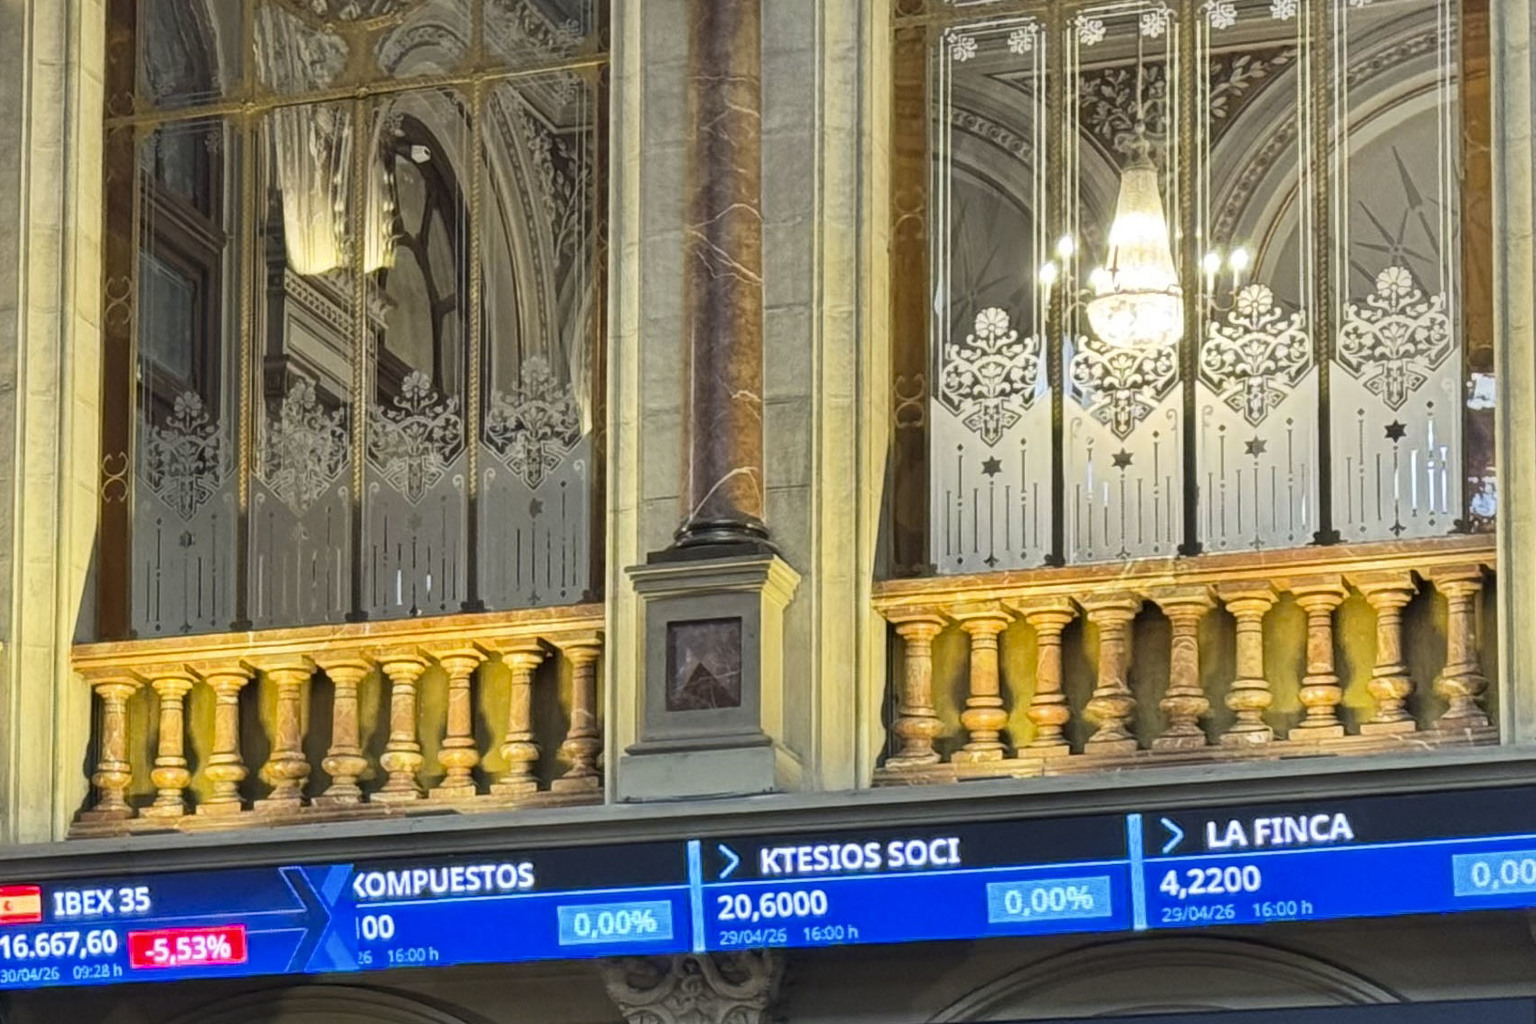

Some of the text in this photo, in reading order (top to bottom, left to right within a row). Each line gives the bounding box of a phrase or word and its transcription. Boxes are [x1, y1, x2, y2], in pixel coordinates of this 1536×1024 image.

[1206, 813, 1353, 849] LA FINCA
[760, 837, 960, 875] KTESIOS SOCI
[1160, 865, 1261, 899] 4,2200
[54, 887, 150, 916] IBEX 35
[718, 890, 827, 923] 20,6000
[1004, 885, 1093, 918] 0,00%
[1161, 900, 1313, 923] 29/04/26 16:00 h
[355, 915, 394, 940] 00
[574, 909, 657, 939] 0,00%
[719, 924, 859, 946] 29/04/26 16:00 h
[145, 935, 230, 964] -5,53%
[389, 948, 426, 963] 16:00
[430, 947, 438, 961] h
[0, 965, 122, 983] 30/04/26 09:28 h
